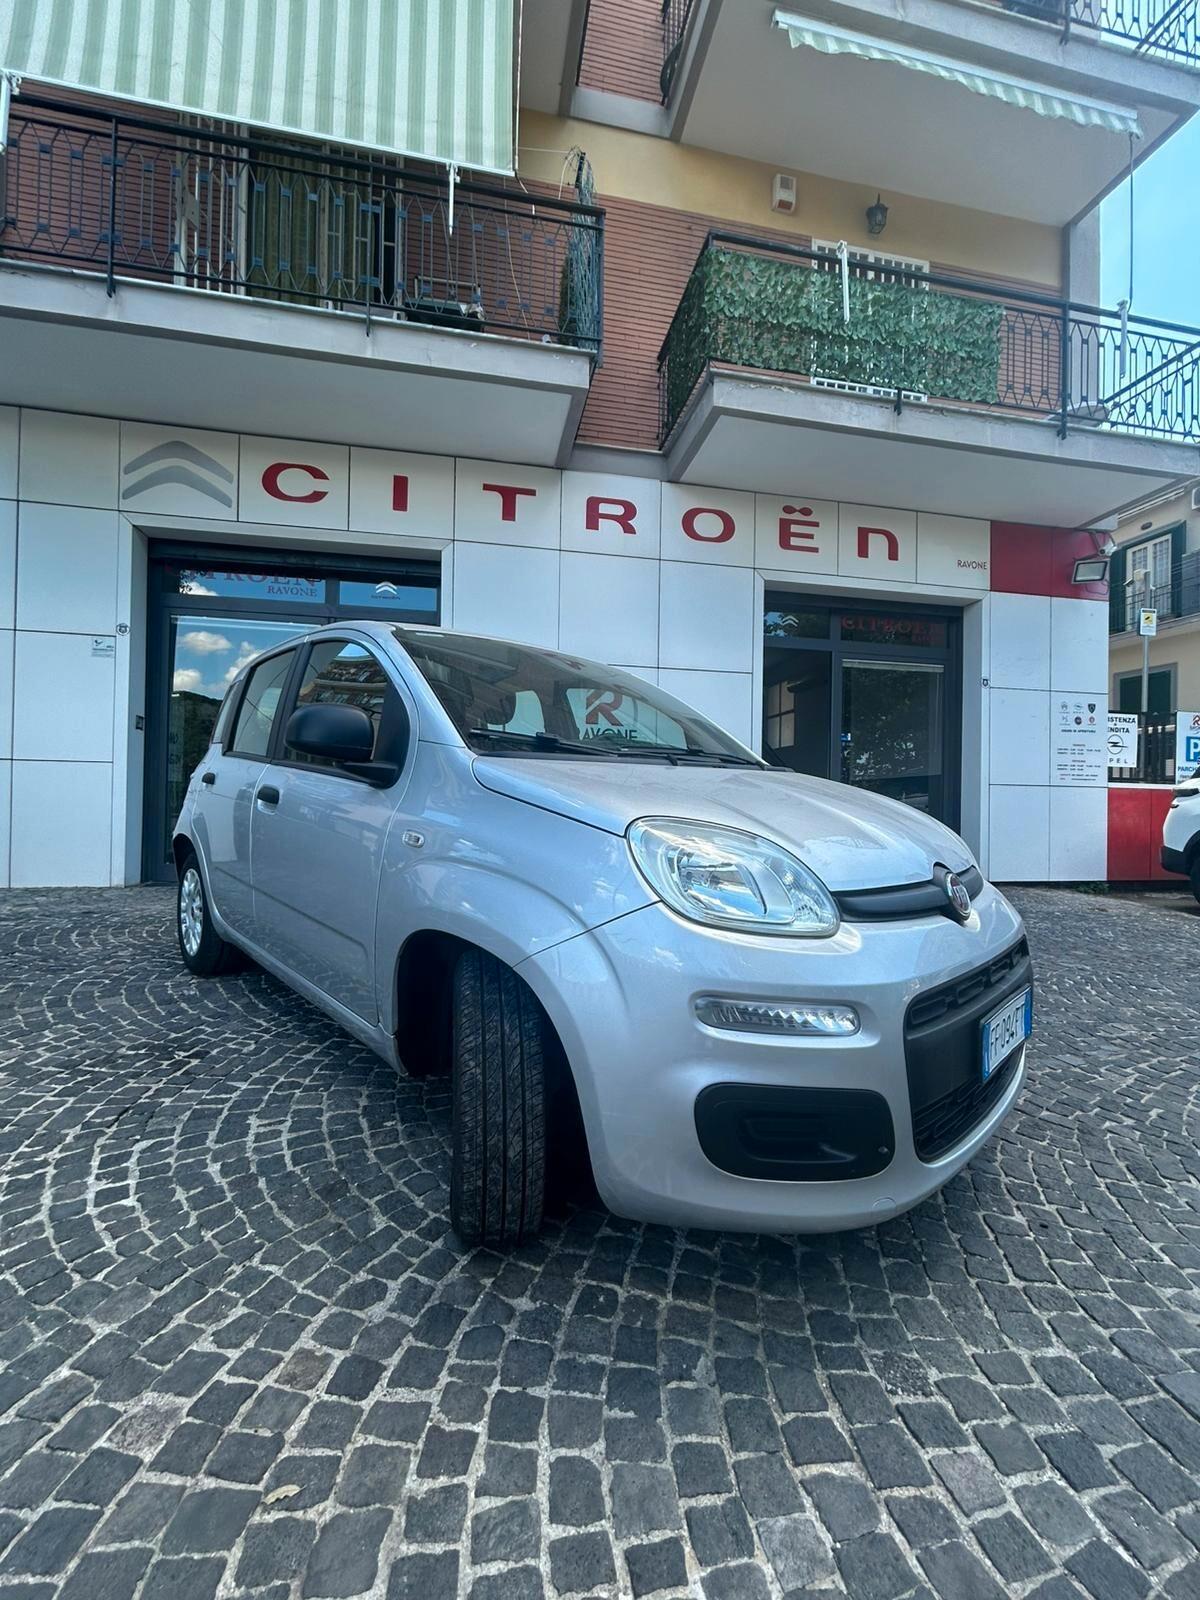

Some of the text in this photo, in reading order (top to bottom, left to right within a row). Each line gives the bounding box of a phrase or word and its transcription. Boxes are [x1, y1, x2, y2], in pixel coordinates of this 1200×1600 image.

[957, 559, 988, 570] RAVONE
[267, 584, 318, 598] RAVONE
[1107, 716, 1136, 724] ISTENZA
[579, 728, 638, 741] AVONE
[1107, 726, 1130, 734] ENDITA
